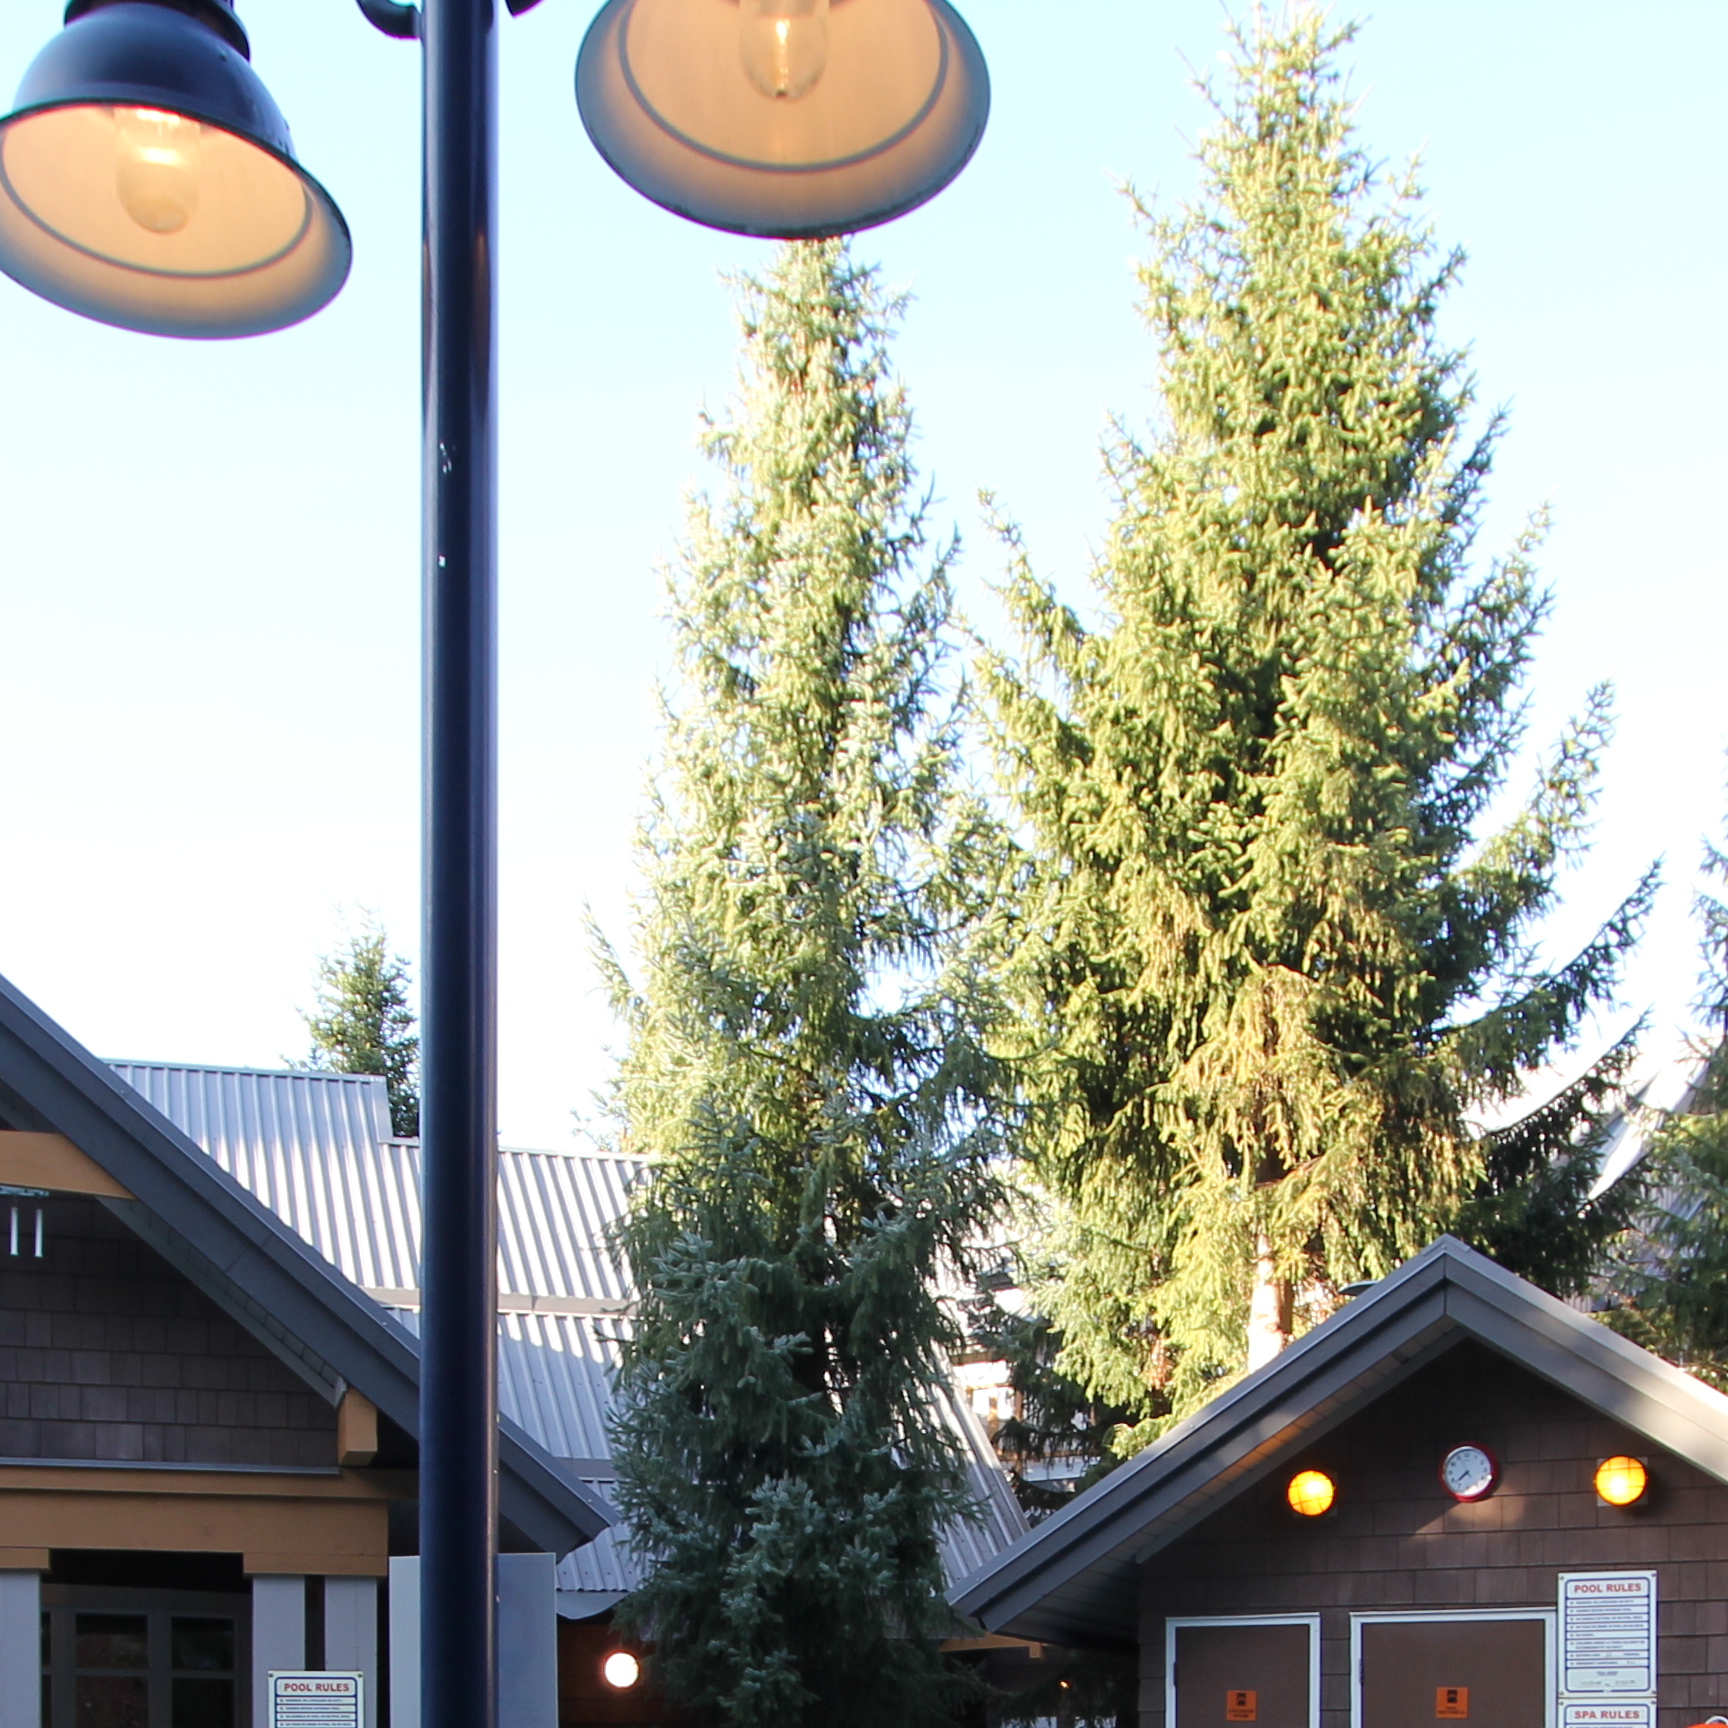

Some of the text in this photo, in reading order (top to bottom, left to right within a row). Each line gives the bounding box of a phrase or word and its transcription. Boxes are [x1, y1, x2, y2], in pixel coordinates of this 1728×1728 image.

[1574, 1582, 1642, 1593] POOL RULES
[284, 1683, 350, 1692] POOL RULES
[1574, 1710, 1640, 1719] SPA RULES
